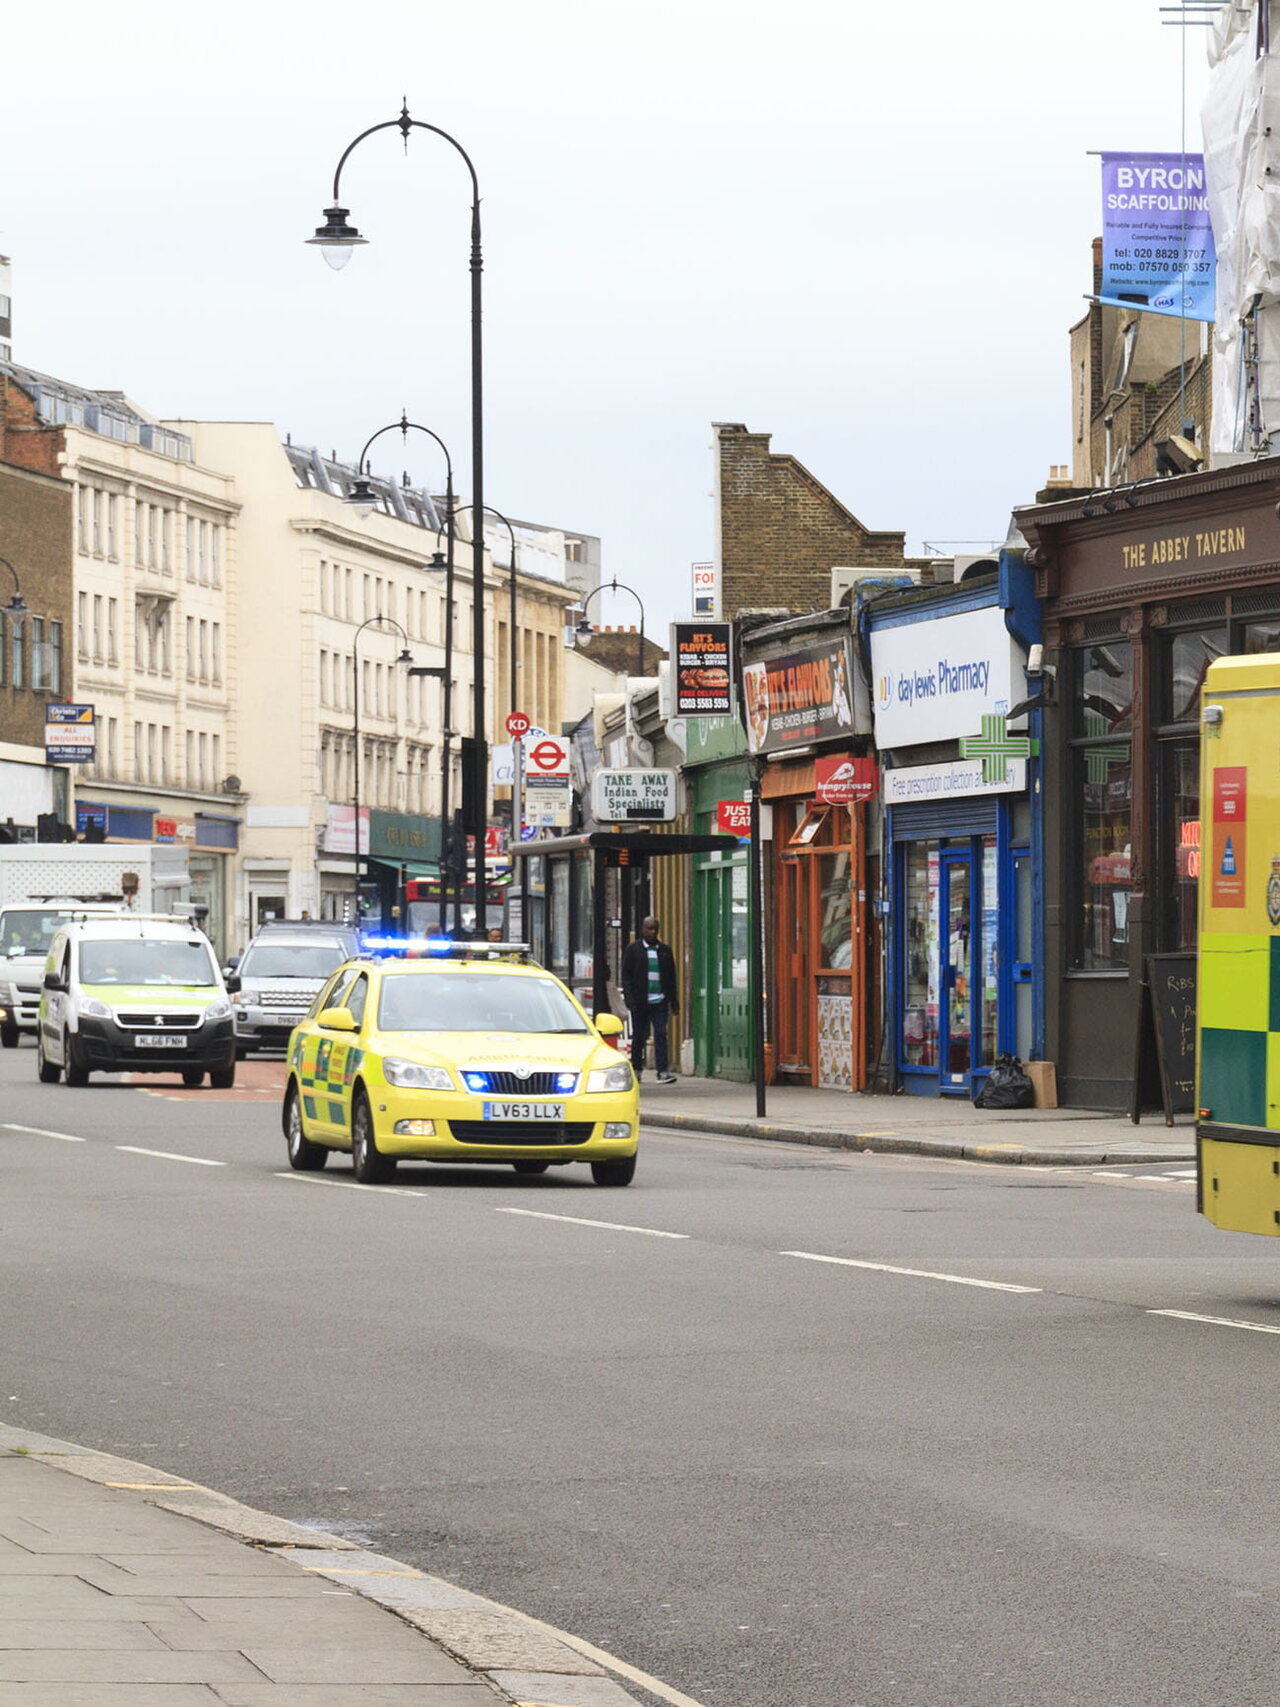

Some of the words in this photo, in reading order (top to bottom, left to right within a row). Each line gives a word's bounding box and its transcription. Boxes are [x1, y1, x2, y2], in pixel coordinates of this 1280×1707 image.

[1117, 168, 1203, 190] BYRON
[1144, 222, 1159, 231] Fully
[1131, 233, 1167, 242] Competitive
[1114, 248, 1132, 258] tel:
[1134, 248, 1153, 258] 020
[1155, 248, 1180, 259] 8829
[1109, 261, 1137, 271] mob:
[1138, 261, 1170, 272] 07570
[1191, 262, 1211, 273] 357
[1122, 543, 1146, 569] THE
[1151, 535, 1191, 564] ABBEY
[1195, 526, 1246, 557] TAVERN
[897, 672, 914, 707] day
[914, 669, 937, 700] lewis
[938, 659, 990, 697] Pharmacy
[697, 689, 728, 697] DELIVERY
[508, 719, 527, 731] KD
[604, 774, 633, 786] TAKE
[641, 774, 669, 786] AWAY
[892, 776, 906, 796] Free
[907, 775, 942, 799] prescription
[943, 769, 973, 792] collection
[604, 786, 638, 797] Indian
[644, 786, 669, 797] Food
[817, 781, 873, 792] hungryhouse
[608, 797, 665, 810] Specialists
[723, 805, 751, 818] JUST
[729, 816, 751, 827] EAT
[491, 1104, 530, 1119] LV63
[534, 1105, 562, 1119] LLX
